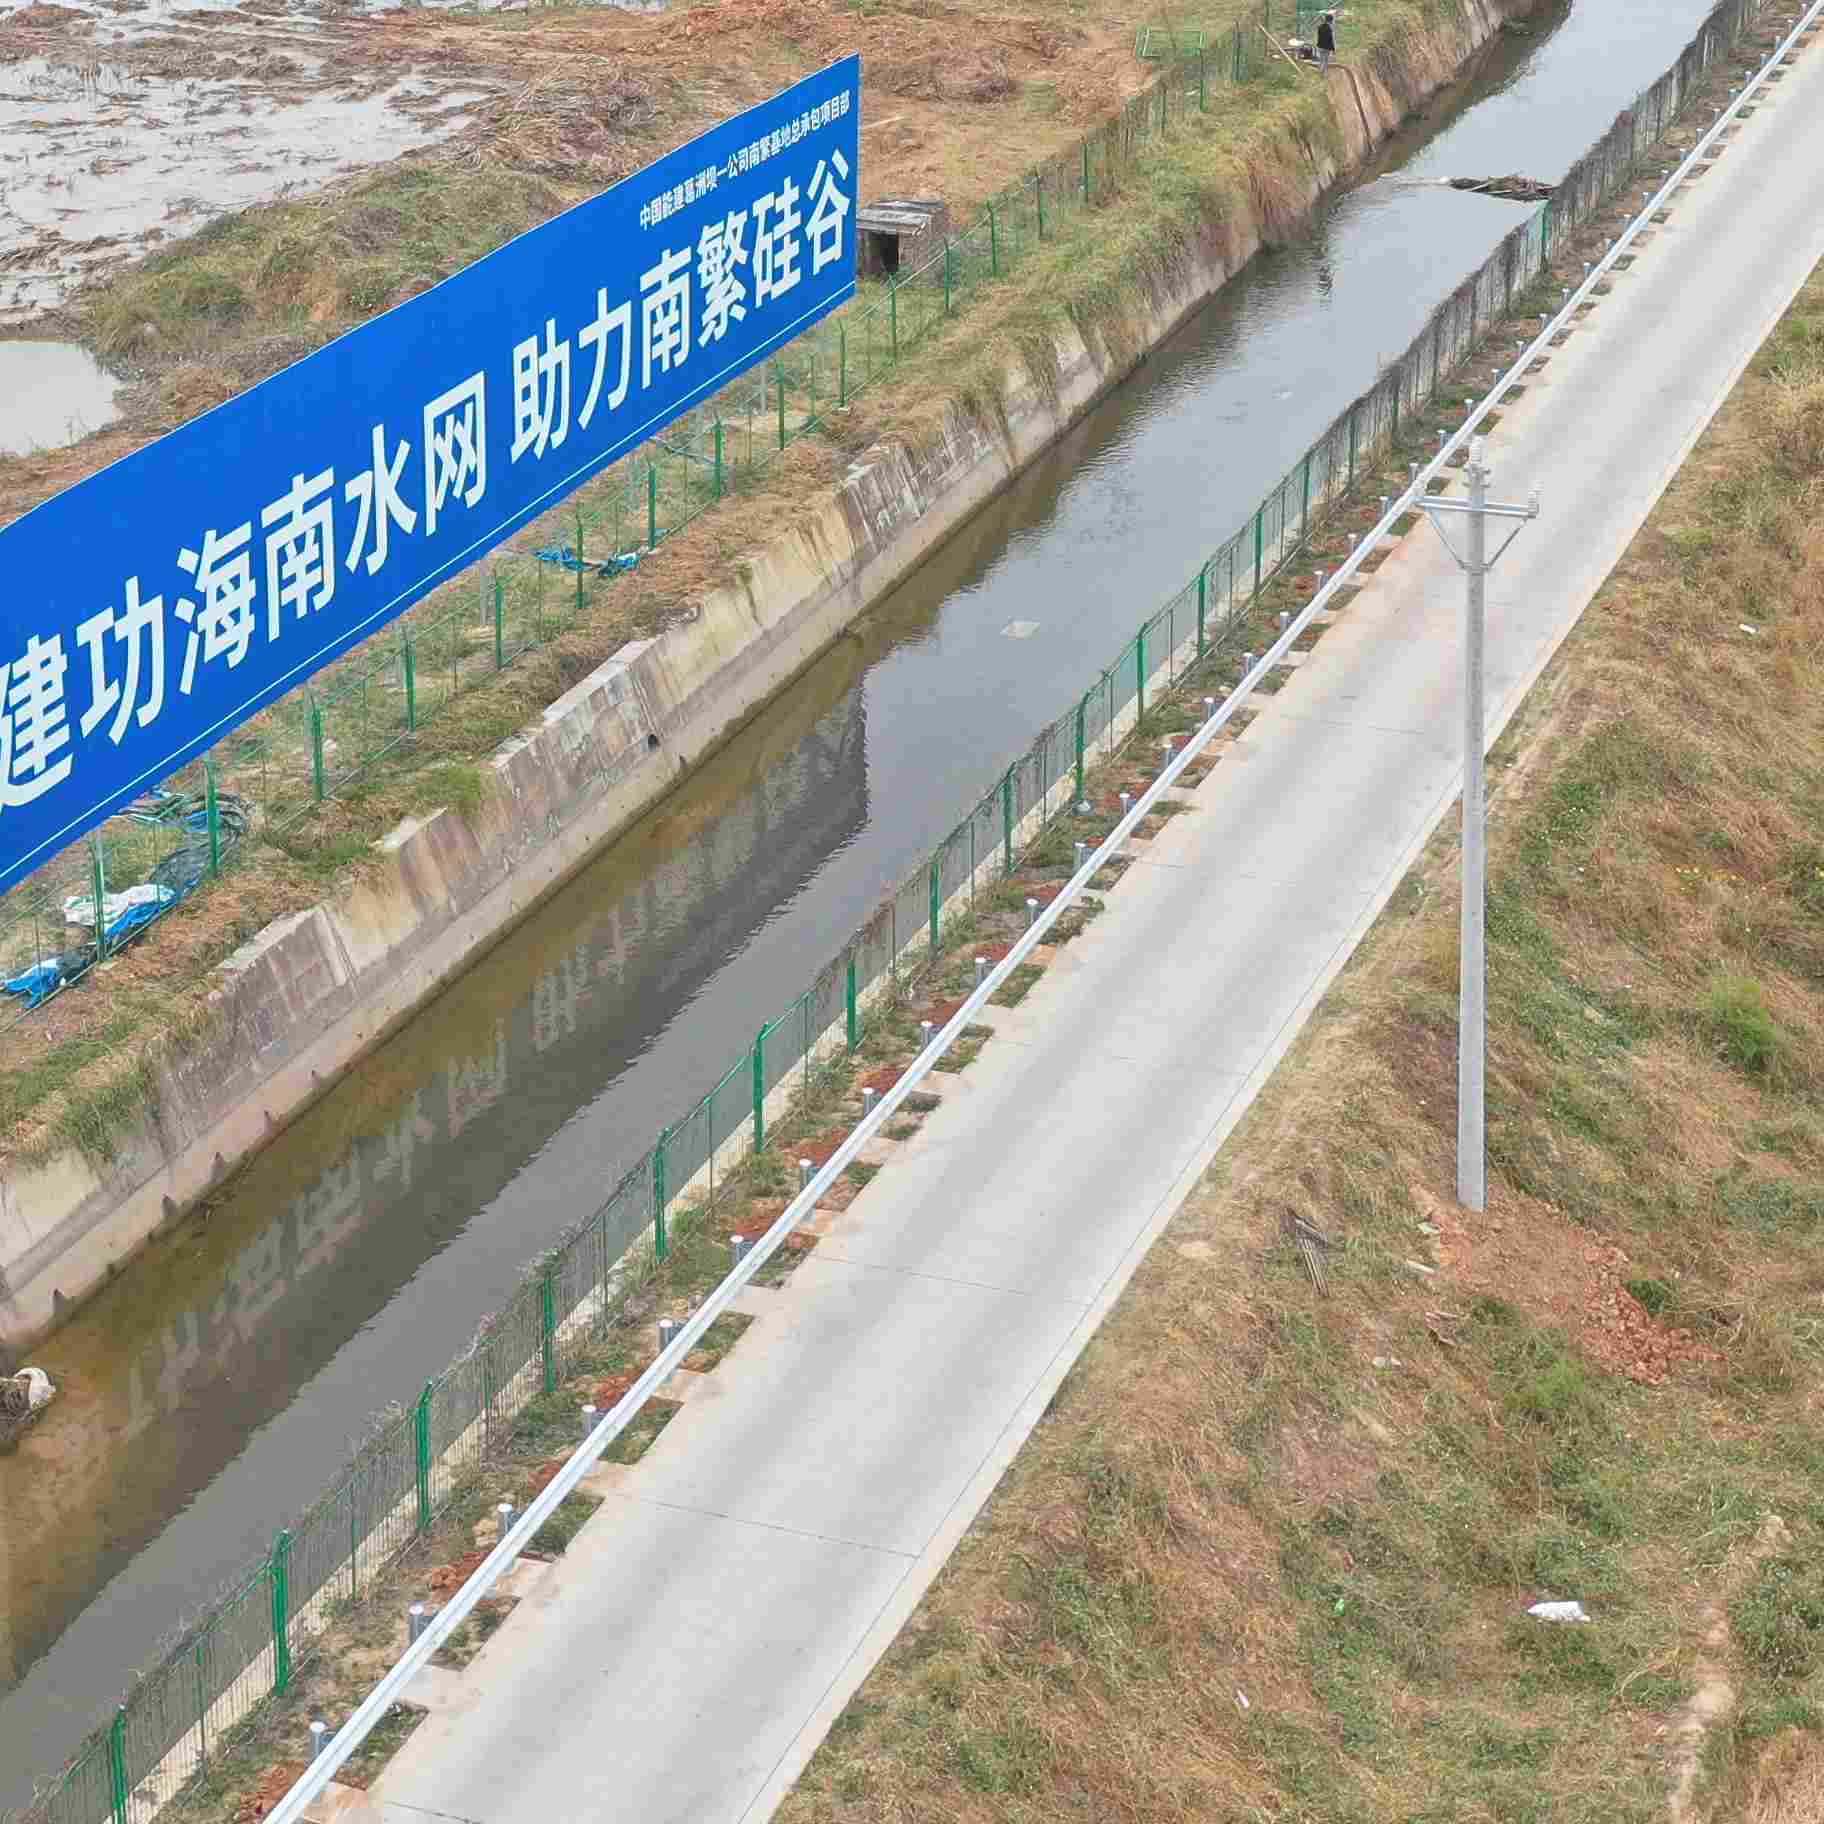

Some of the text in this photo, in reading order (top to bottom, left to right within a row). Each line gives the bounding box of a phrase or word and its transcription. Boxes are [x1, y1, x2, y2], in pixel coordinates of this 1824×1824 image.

[511, 148, 852, 464] 助力南繁硅谷
